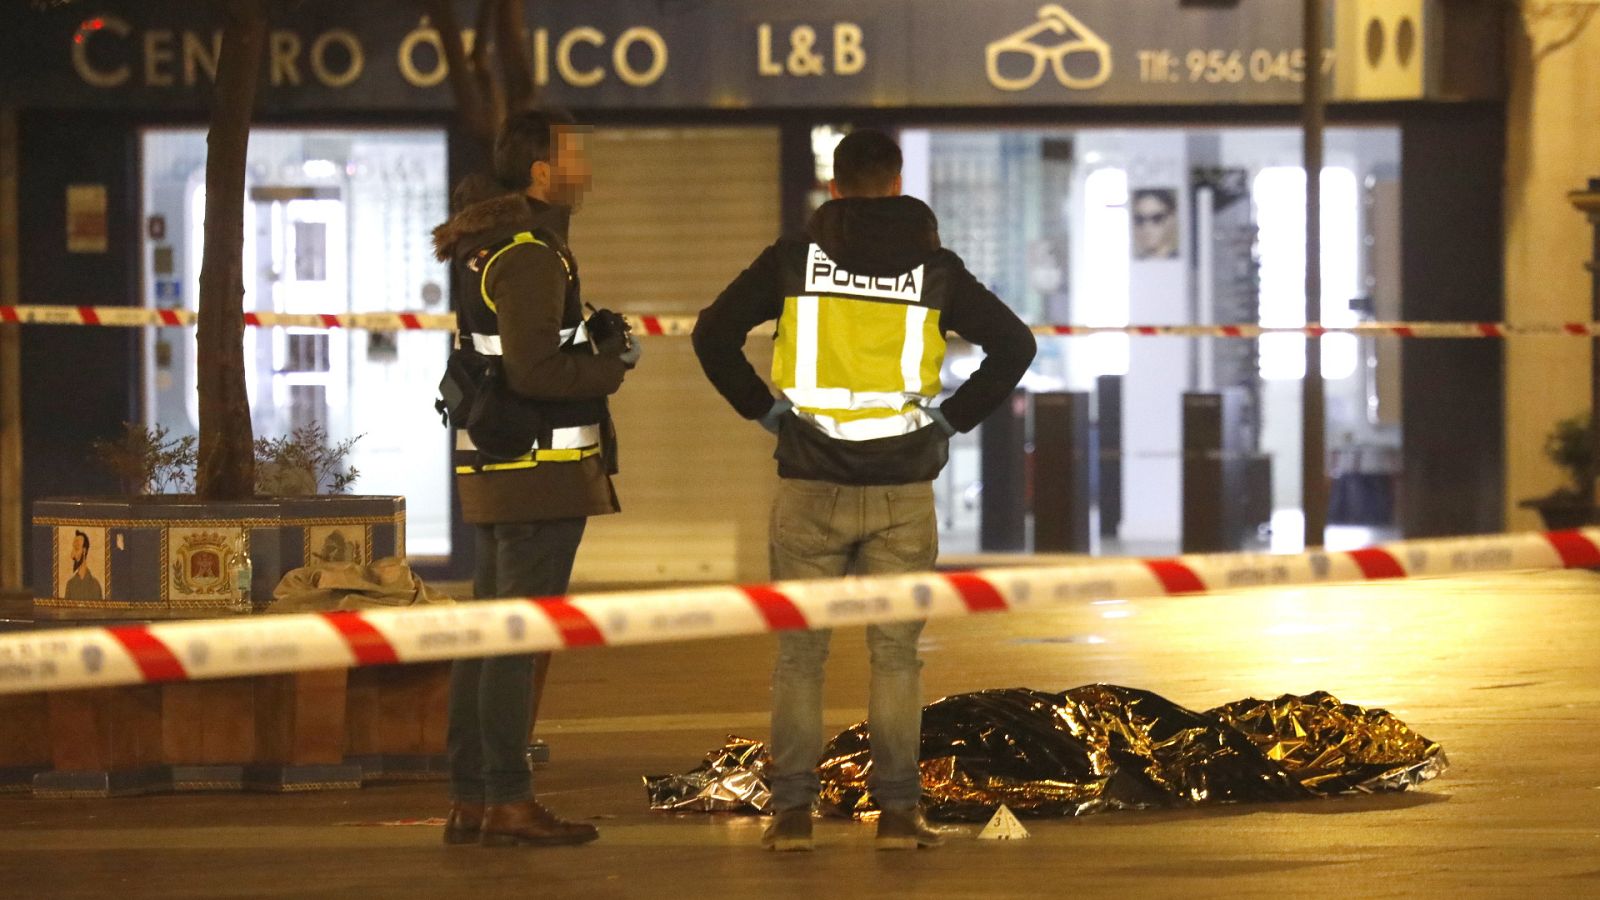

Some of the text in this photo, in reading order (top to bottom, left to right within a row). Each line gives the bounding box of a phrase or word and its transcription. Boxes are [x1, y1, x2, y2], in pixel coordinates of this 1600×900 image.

[72, 15, 669, 87] CENRO ÓICO
[757, 22, 867, 77] L&B
[1186, 49, 1245, 83] 956
[993, 816, 1002, 828] 3
